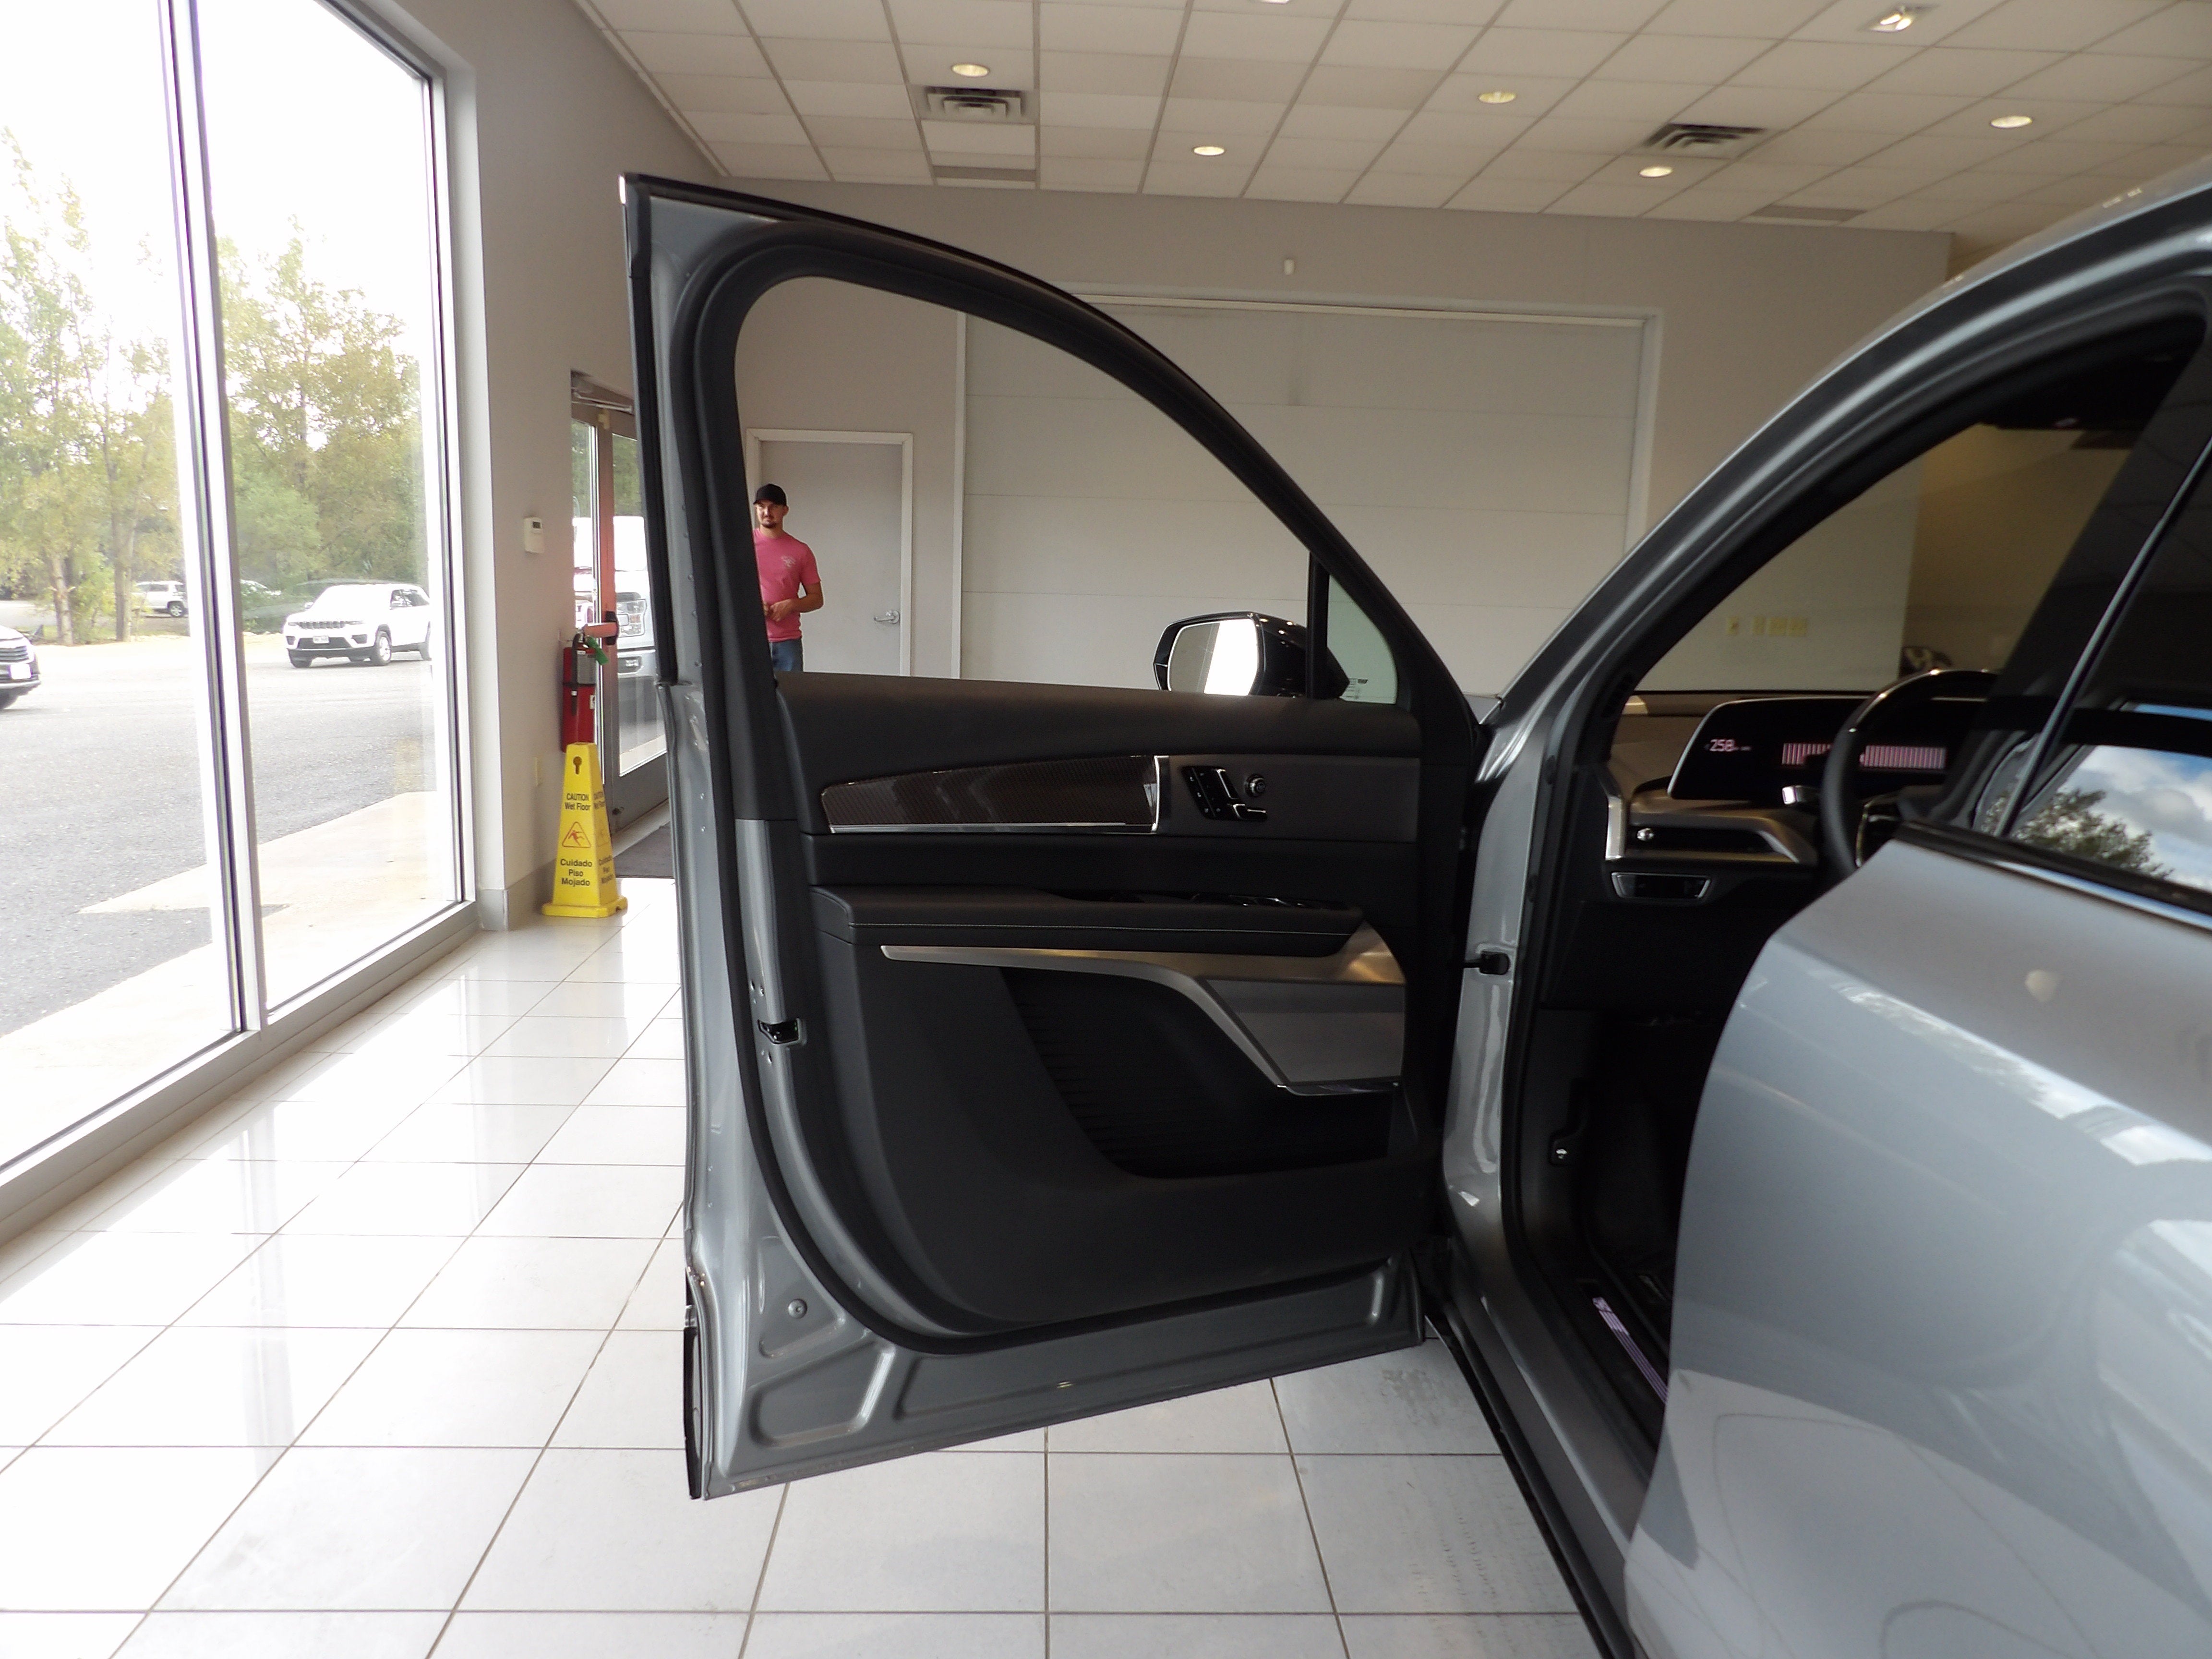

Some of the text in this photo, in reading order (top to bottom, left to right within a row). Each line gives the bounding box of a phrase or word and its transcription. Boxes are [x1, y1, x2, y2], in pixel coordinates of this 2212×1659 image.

[1709, 739, 1735, 752] 258
[577, 803, 590, 811] Floor
[560, 858, 592, 867] Cuidado
[561, 878, 590, 887] Mojado
